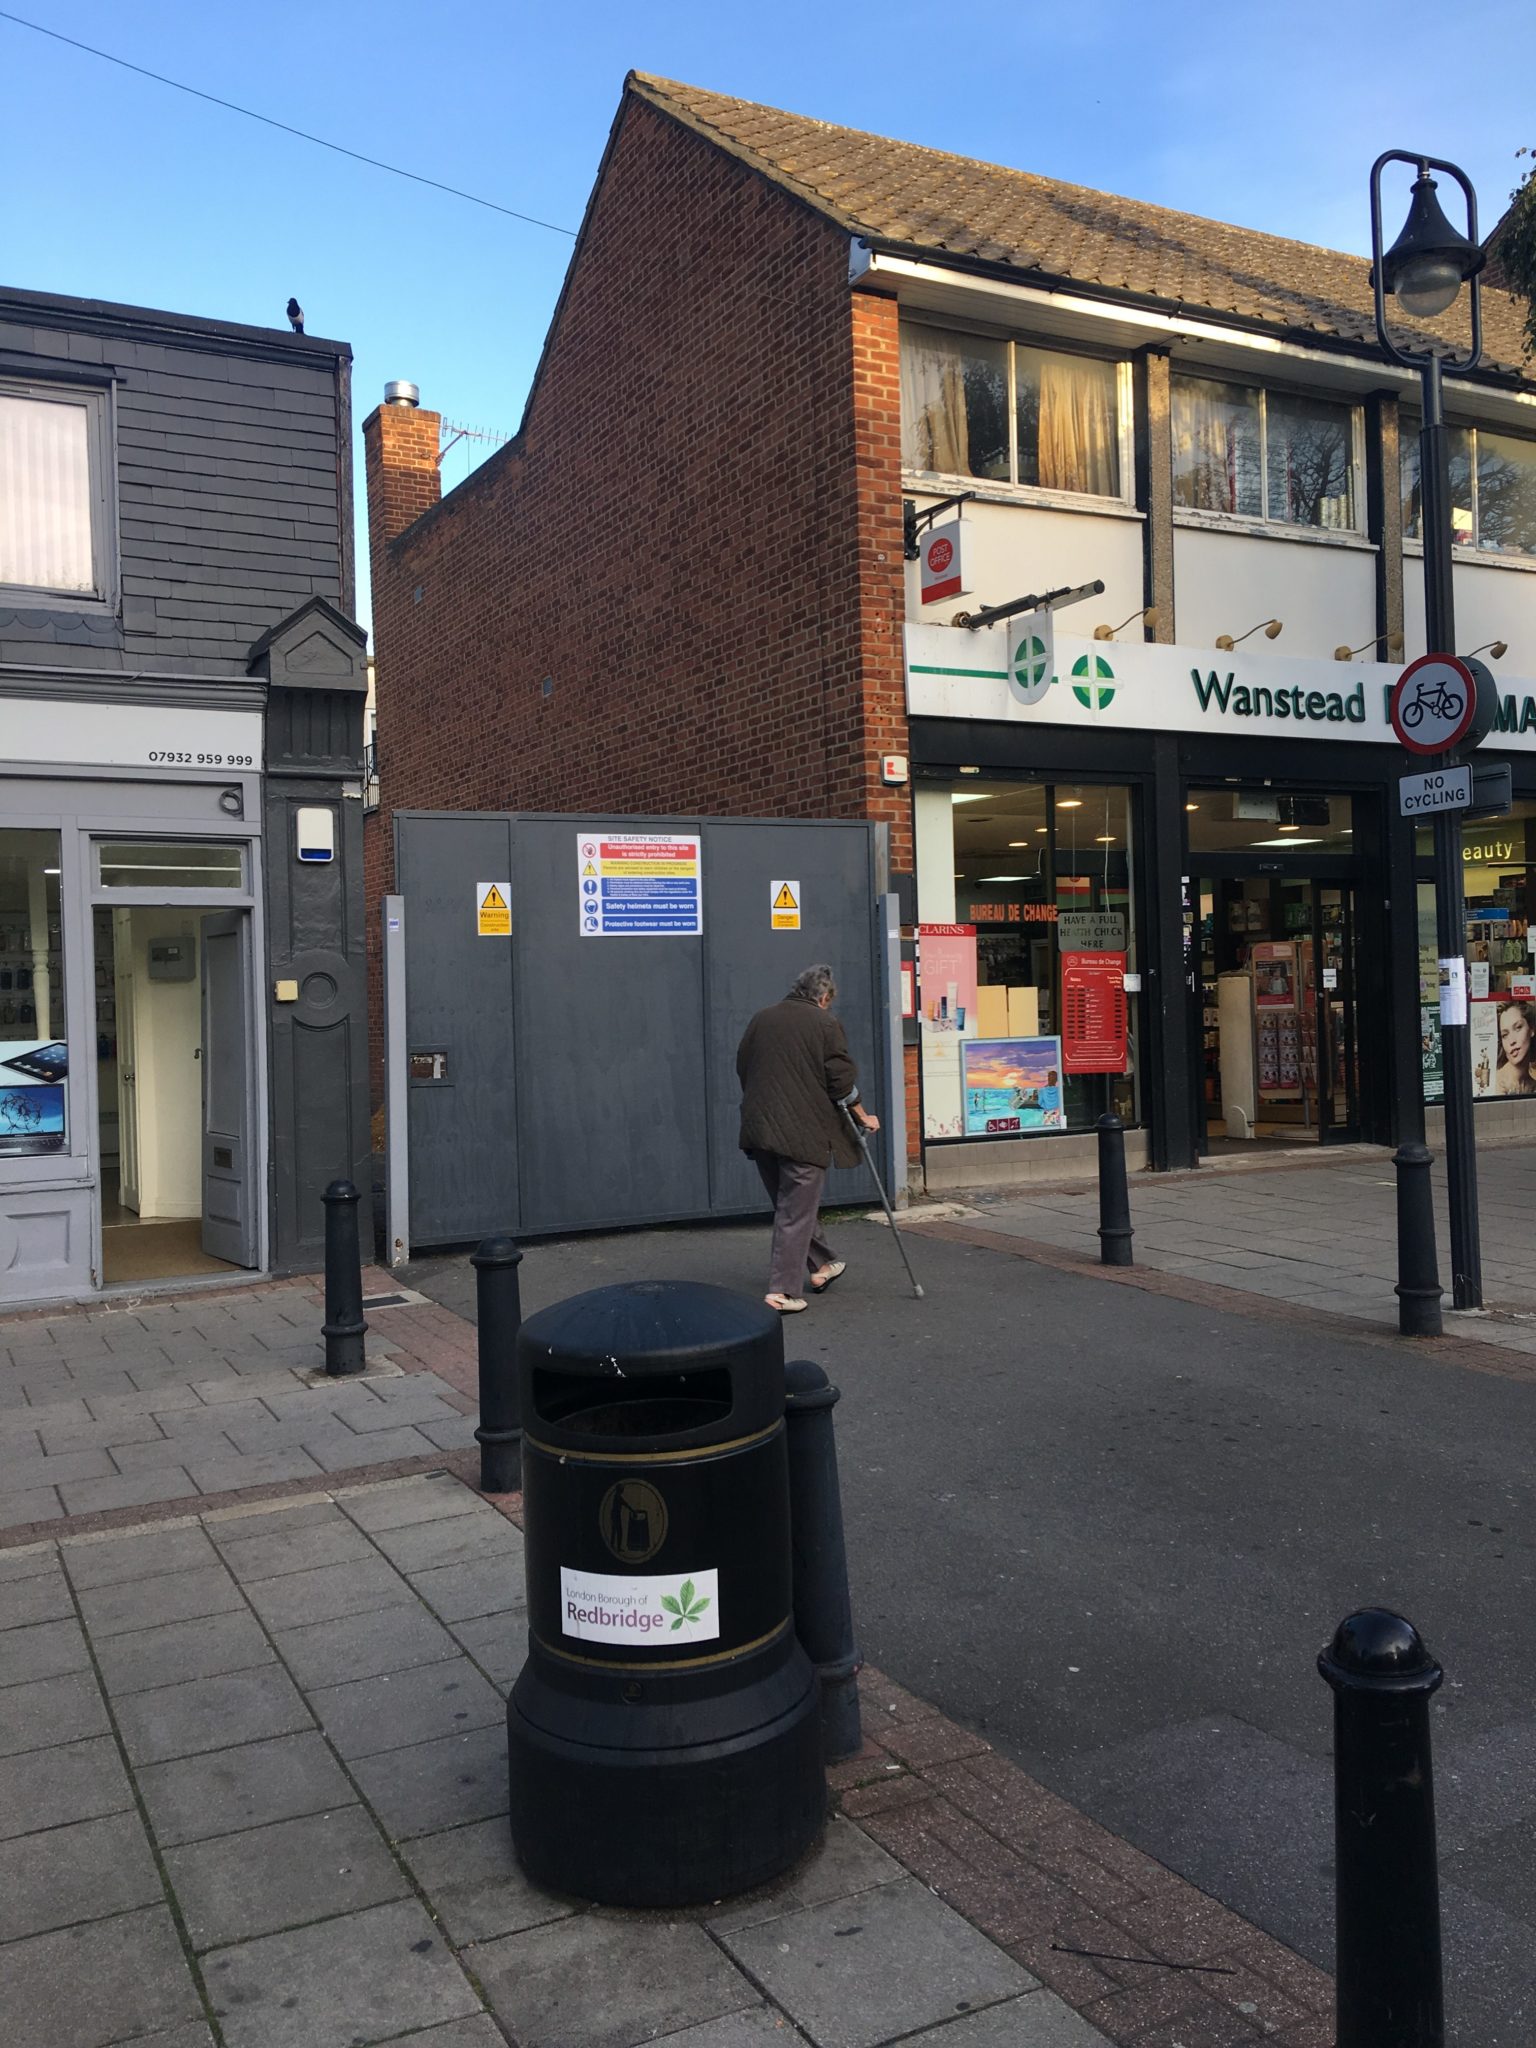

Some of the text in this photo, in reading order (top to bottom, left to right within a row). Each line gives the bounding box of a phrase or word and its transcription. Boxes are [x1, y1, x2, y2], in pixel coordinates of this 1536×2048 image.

[932, 543, 948, 556] POST
[930, 552, 950, 566] OFFICE
[1190, 668, 1366, 723] Wanstead
[148, 751, 253, 766] 07932 959 999
[1424, 776, 1444, 791] NO
[1404, 788, 1465, 809] CYCLING
[1462, 841, 1513, 861] eauty
[606, 902, 626, 911] Safety
[627, 902, 652, 910] helmets
[969, 904, 1058, 921] BUREAU DE CHANGE
[604, 920, 633, 928] Protective
[634, 920, 659, 928] footwear
[1063, 915, 1118, 925] HAVE A FULL
[919, 925, 965, 935] CLARINS
[924, 959, 960, 976] GIFT
[566, 1587, 648, 1607] London Borough of
[567, 1601, 664, 1632] Redbridge
